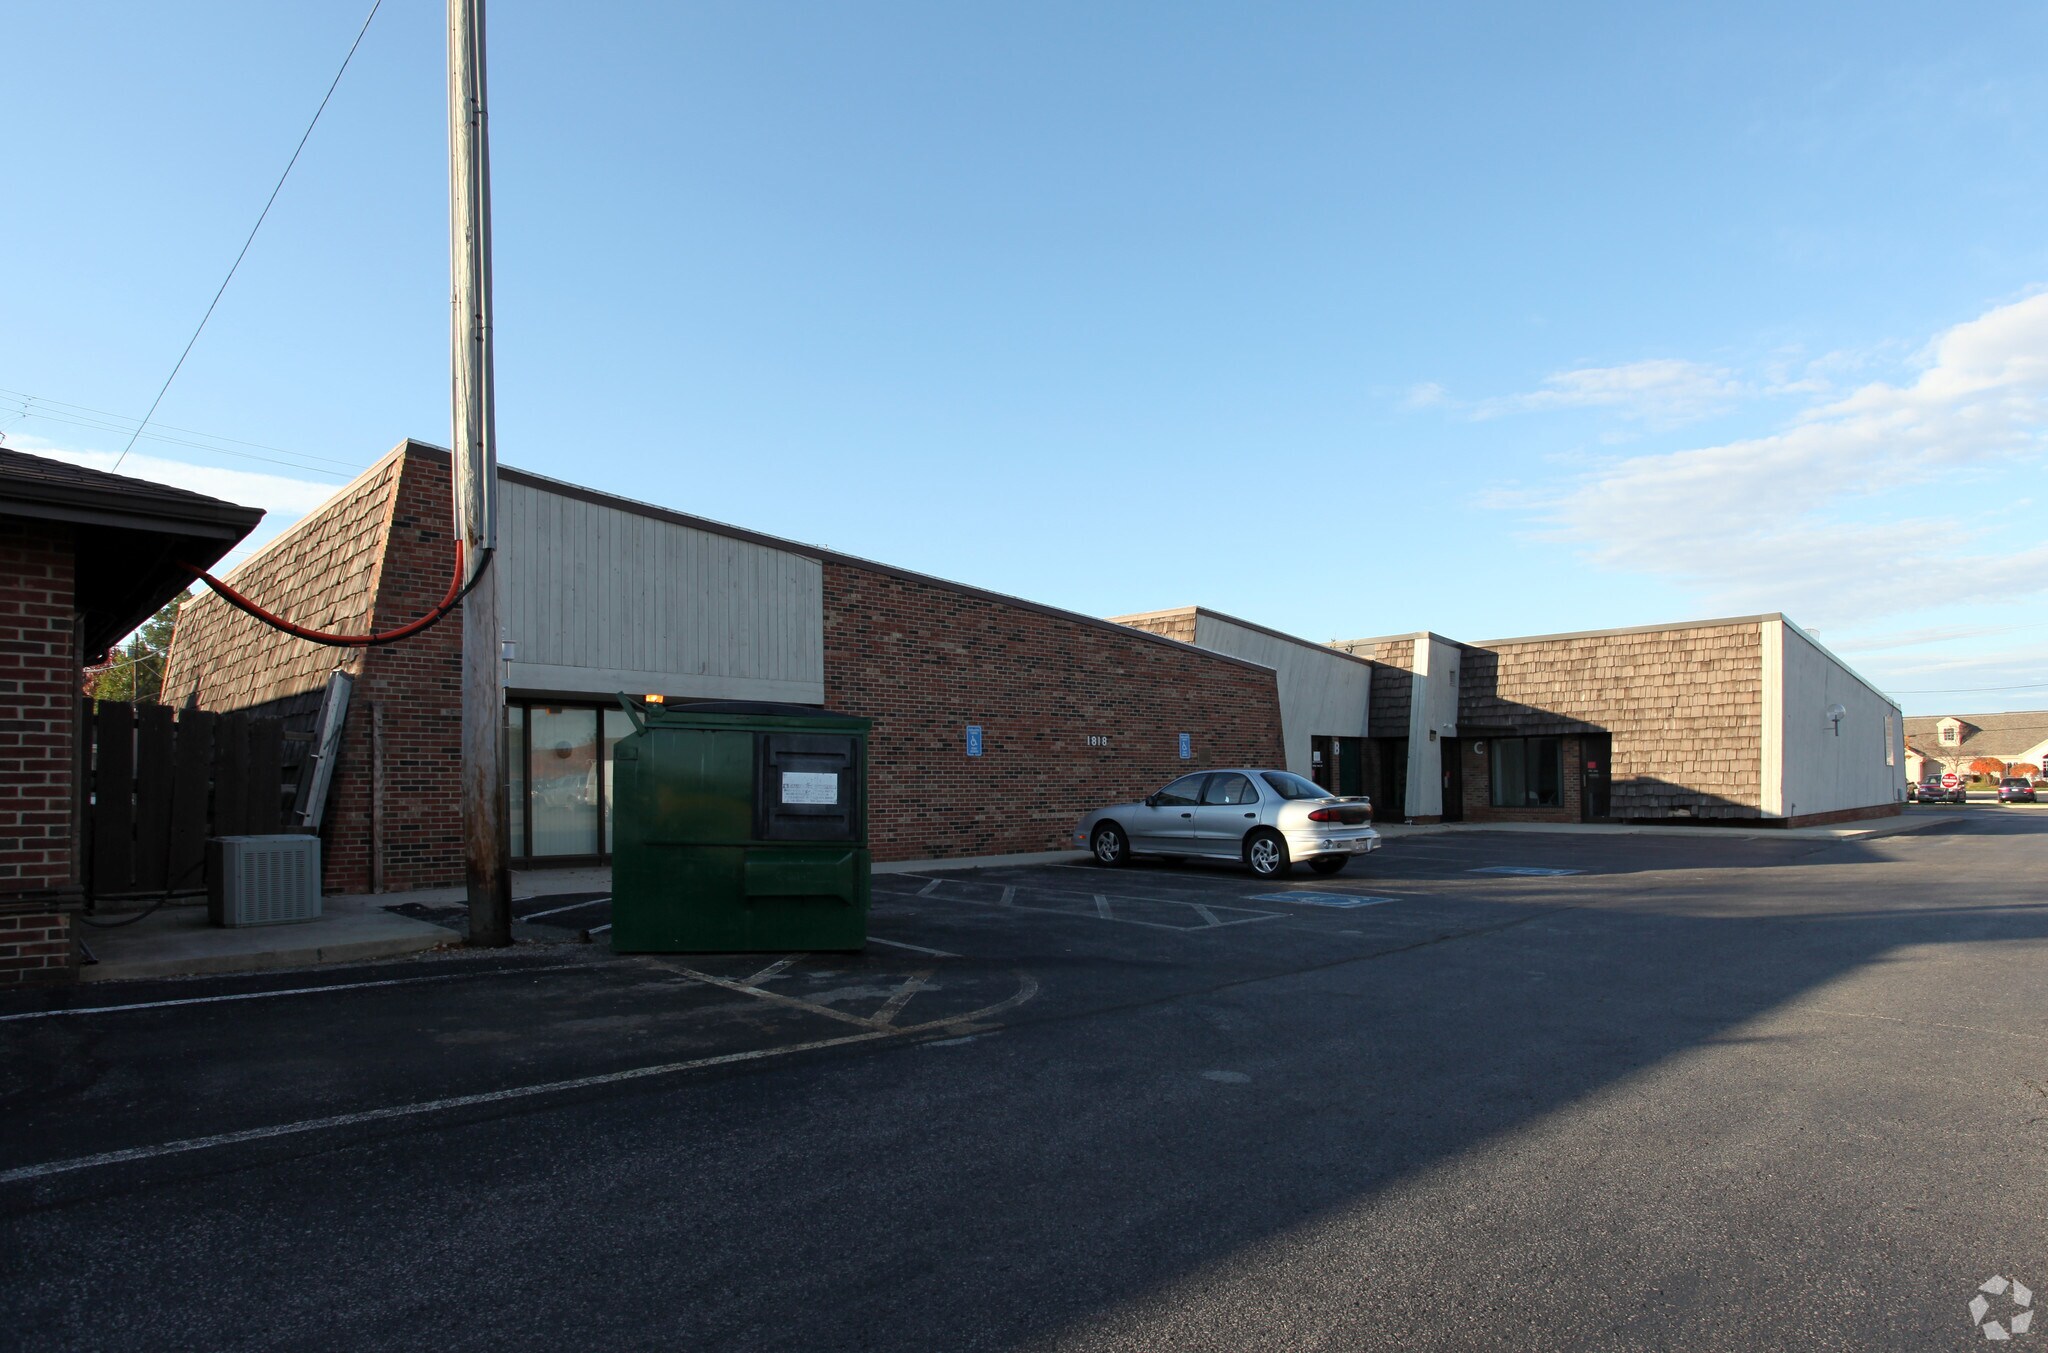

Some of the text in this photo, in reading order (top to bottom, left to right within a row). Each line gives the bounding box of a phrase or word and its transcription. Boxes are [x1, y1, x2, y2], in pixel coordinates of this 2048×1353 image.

[1087, 735, 1107, 746] 1818
[1334, 741, 1340, 755] B
[1474, 741, 1483, 754] C
